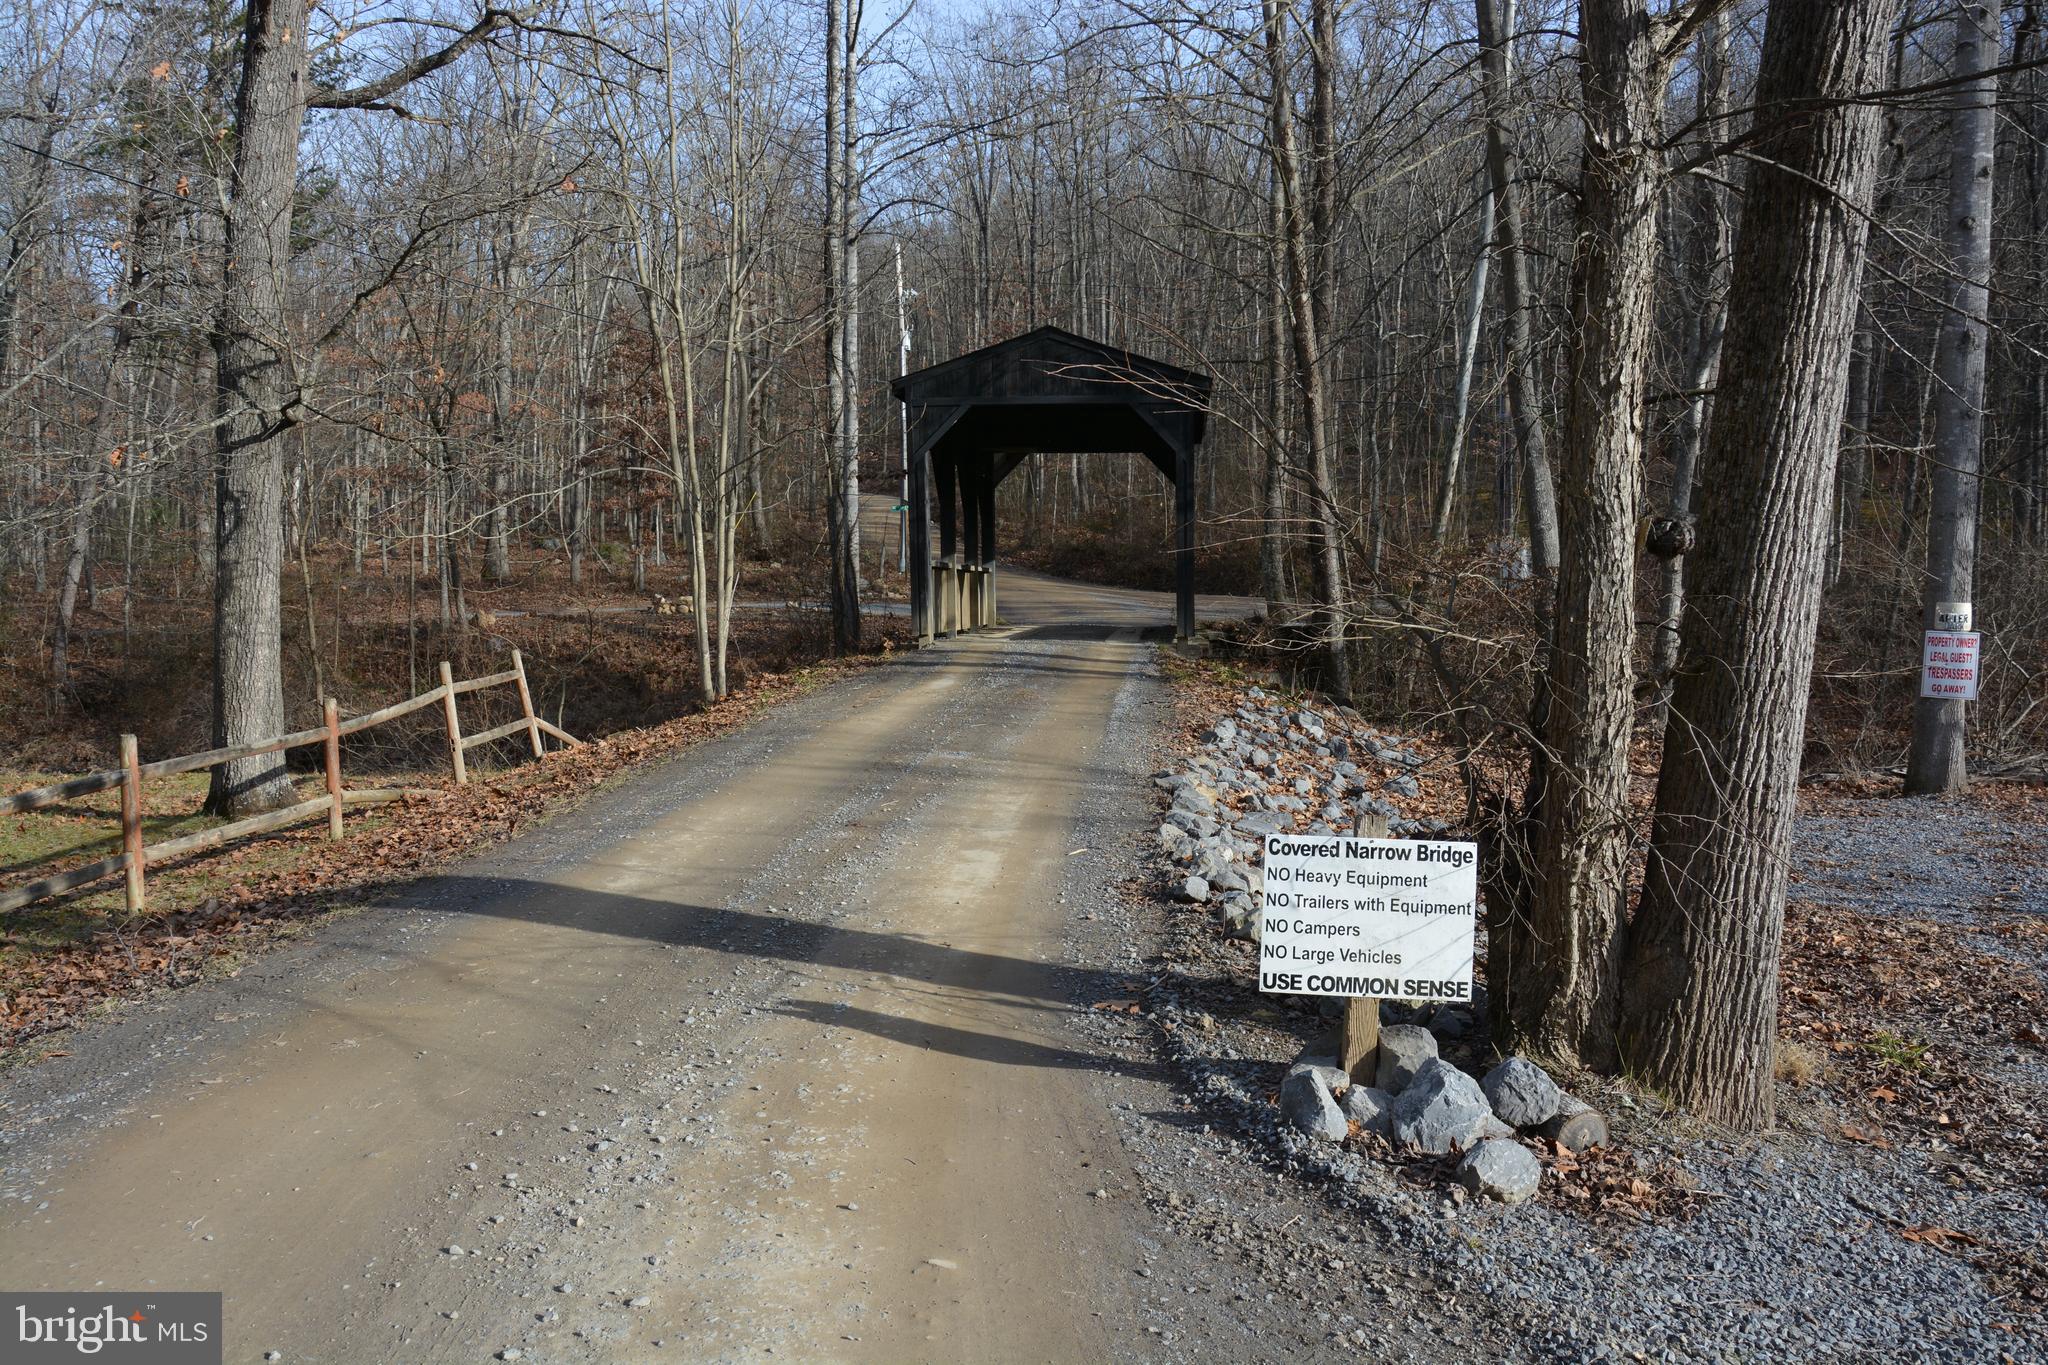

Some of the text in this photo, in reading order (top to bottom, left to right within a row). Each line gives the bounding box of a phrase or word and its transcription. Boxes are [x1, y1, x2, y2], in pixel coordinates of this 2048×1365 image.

[1928, 636, 1977, 649] PROPERTY OWNER?
[1930, 651, 1973, 664] LEGAL GUEST?
[1928, 667, 1973, 680] TRESPASSERS
[1931, 684, 1966, 694] GO AWAY!
[1268, 838, 1474, 867] Covered Narrow Bridge
[1267, 867, 1428, 889] NO Heavy Equipment
[1266, 893, 1472, 917] NO Trailers with Equipment
[1265, 919, 1361, 938] NO Campers
[1264, 945, 1402, 965] NO Large Vehicles
[1262, 973, 1469, 998] USE COMMON SENSE
